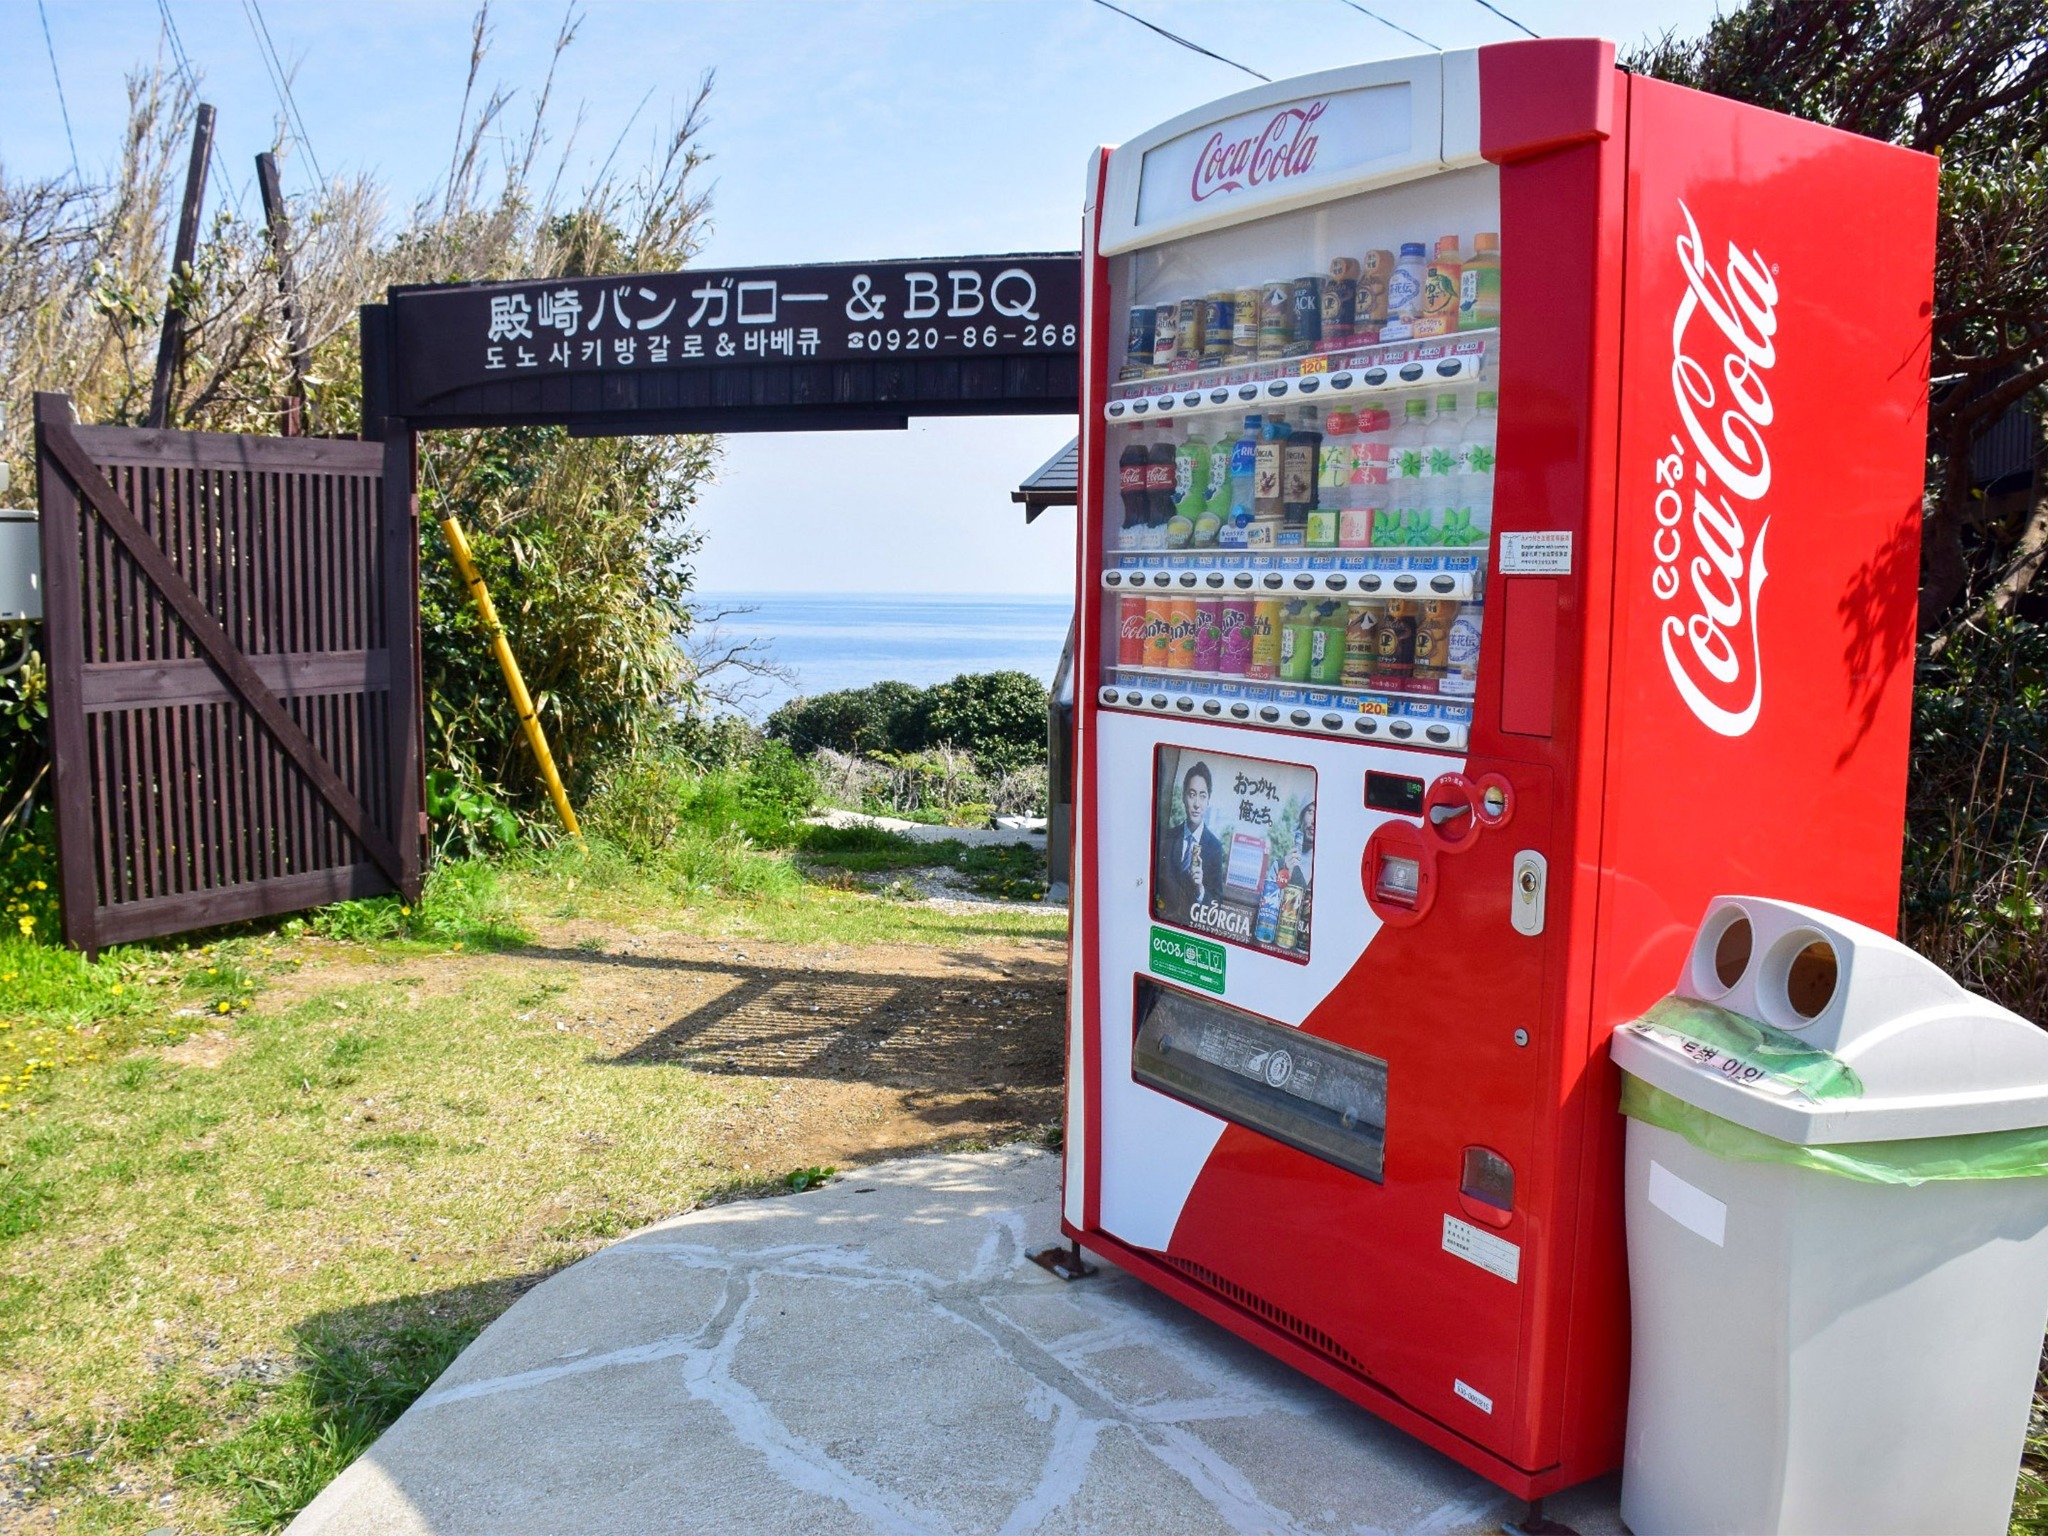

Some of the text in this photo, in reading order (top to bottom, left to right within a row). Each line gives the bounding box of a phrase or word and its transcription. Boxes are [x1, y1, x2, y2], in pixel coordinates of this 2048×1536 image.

[1191, 98, 1331, 202] Coca-Cola
[487, 267, 1040, 342] 殿崎バンガロー & BBQ
[715, 332, 736, 357] &
[1661, 197, 1779, 737] Coca-Cola
[1190, 899, 1250, 937] GEORGIA
